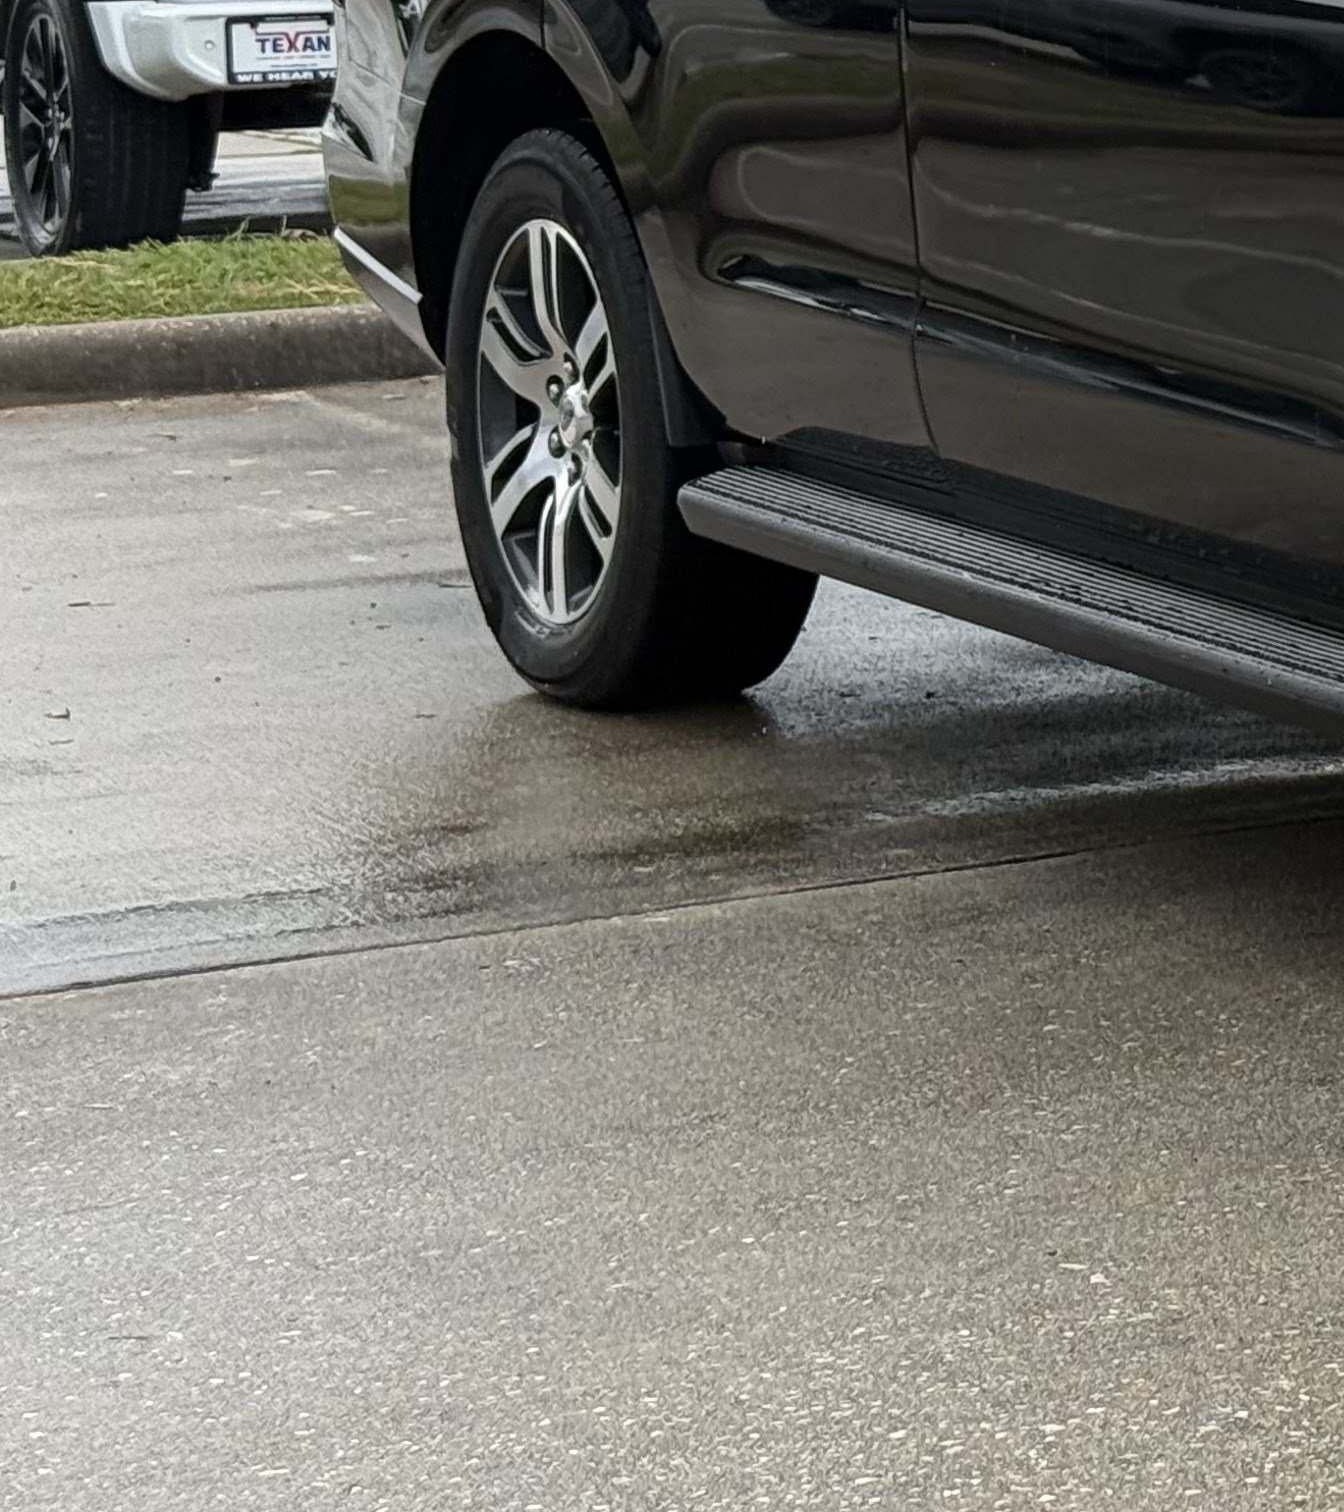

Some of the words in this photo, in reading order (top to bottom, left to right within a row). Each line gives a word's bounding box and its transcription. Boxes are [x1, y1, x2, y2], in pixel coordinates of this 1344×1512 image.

[255, 29, 331, 54] TEXAN
[236, 72, 264, 83] WE
[268, 70, 315, 82] HEAR
